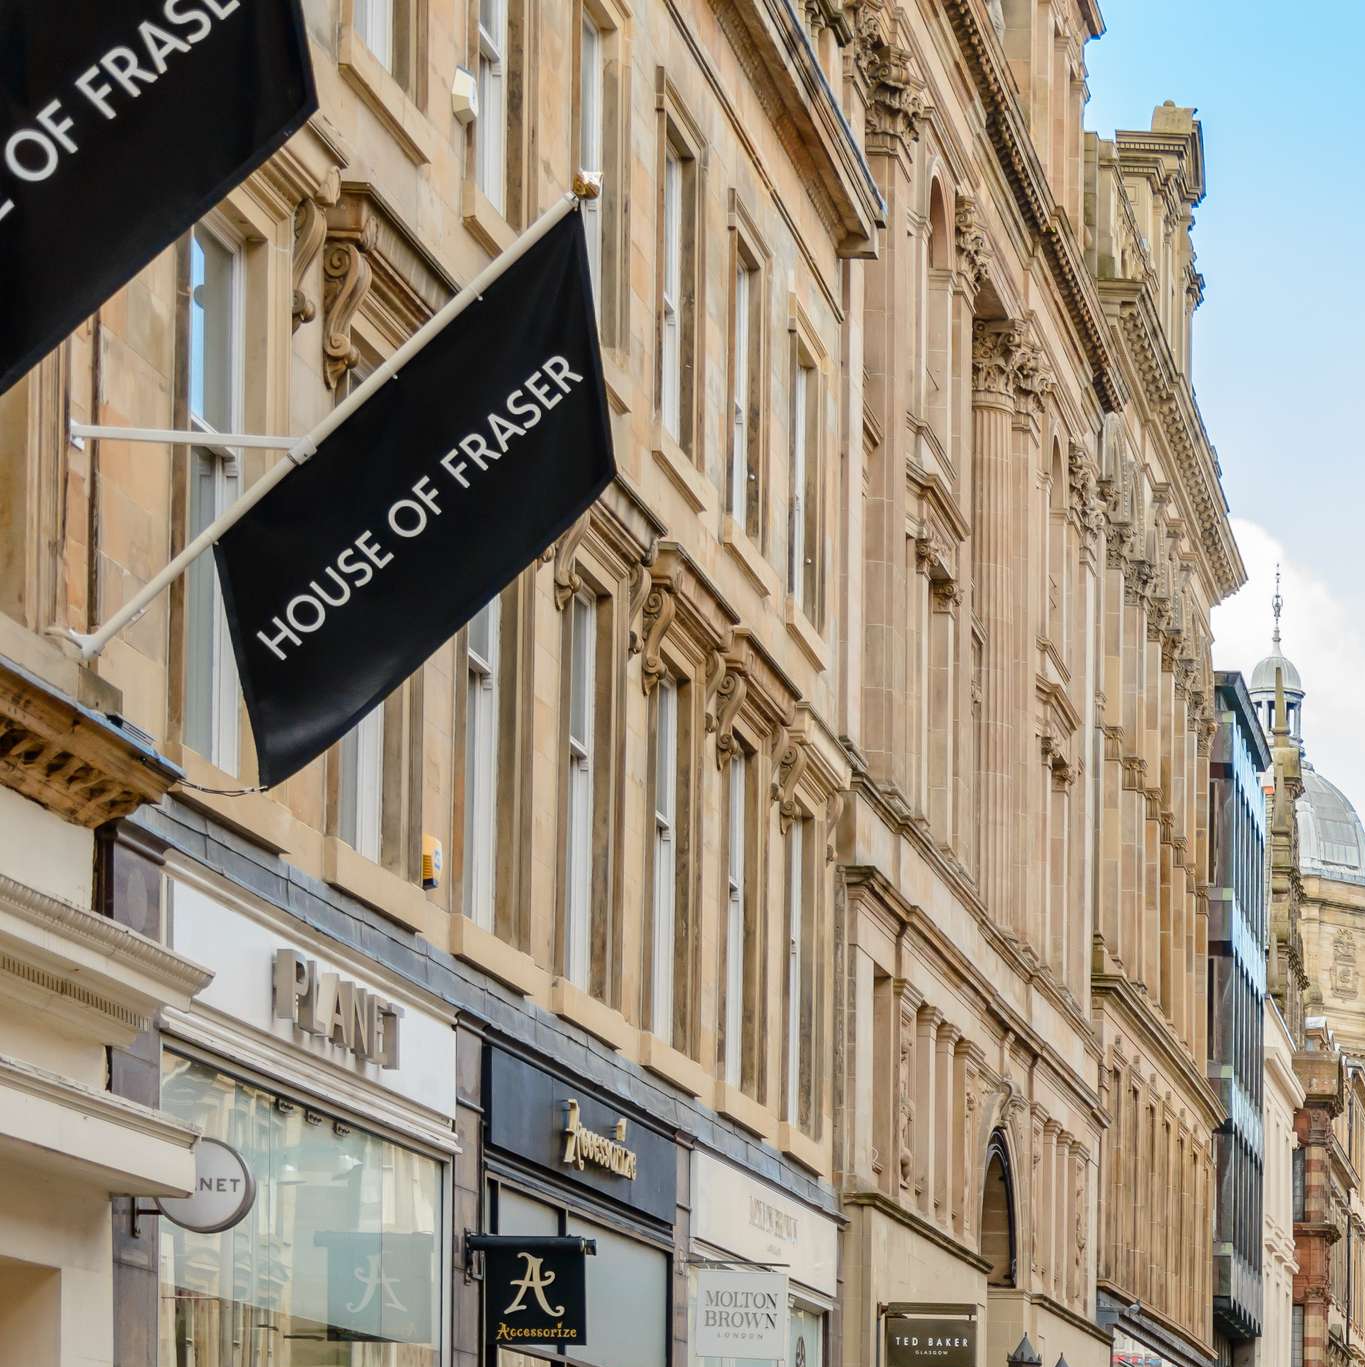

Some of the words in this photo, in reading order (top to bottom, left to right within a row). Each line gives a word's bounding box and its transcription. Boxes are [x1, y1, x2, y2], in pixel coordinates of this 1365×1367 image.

[4, 99, 79, 182] OF
[74, 0, 241, 120] FRAS
[256, 530, 394, 661] HOUSE
[387, 475, 450, 538] OF
[440, 355, 584, 489] FRASER
[274, 947, 404, 1070] PLANET
[199, 1176, 241, 1193] NET
[704, 1290, 779, 1310] MOLTON
[704, 1309, 779, 1329] BROWN
[496, 1321, 578, 1340] Accessorize
[716, 1331, 765, 1340] LONDON
[895, 1336, 919, 1347] TED
[927, 1337, 969, 1348] BAKER
